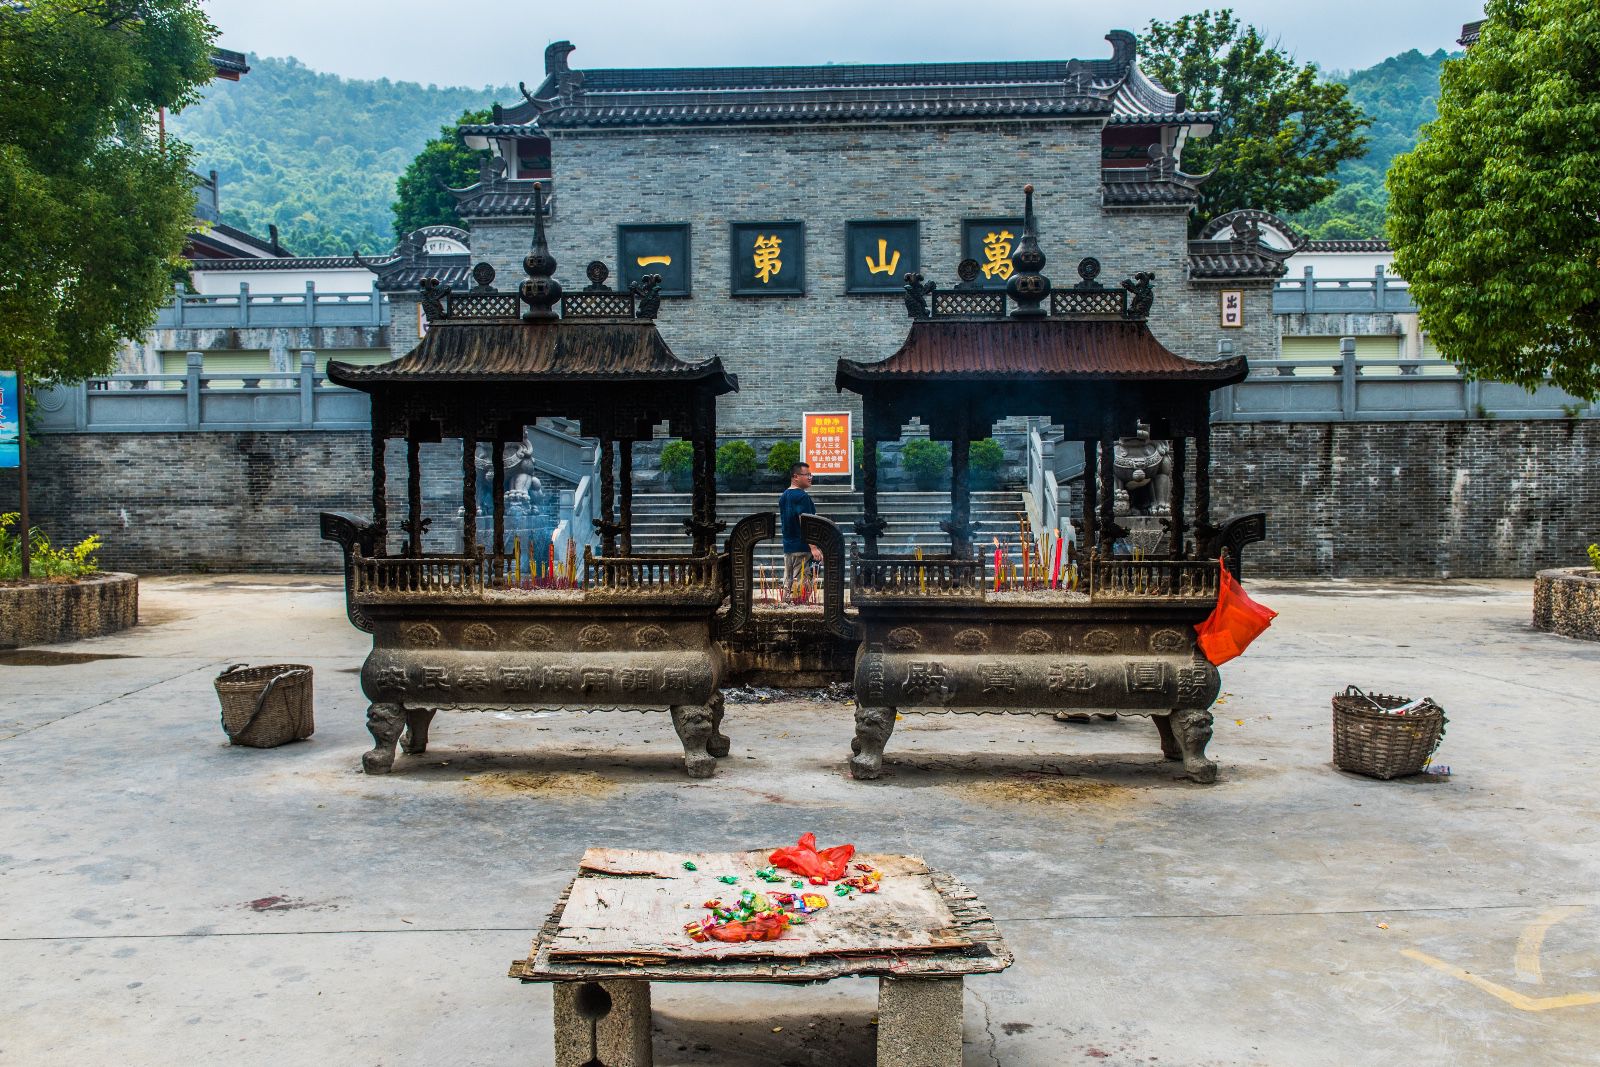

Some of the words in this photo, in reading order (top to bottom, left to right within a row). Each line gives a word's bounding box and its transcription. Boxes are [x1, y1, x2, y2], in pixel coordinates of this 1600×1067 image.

[637, 255, 672, 267] 一
[752, 234, 783, 284] 第
[865, 239, 901, 277] 山
[981, 230, 1014, 281] 萬
[1226, 294, 1237, 323] 出口
